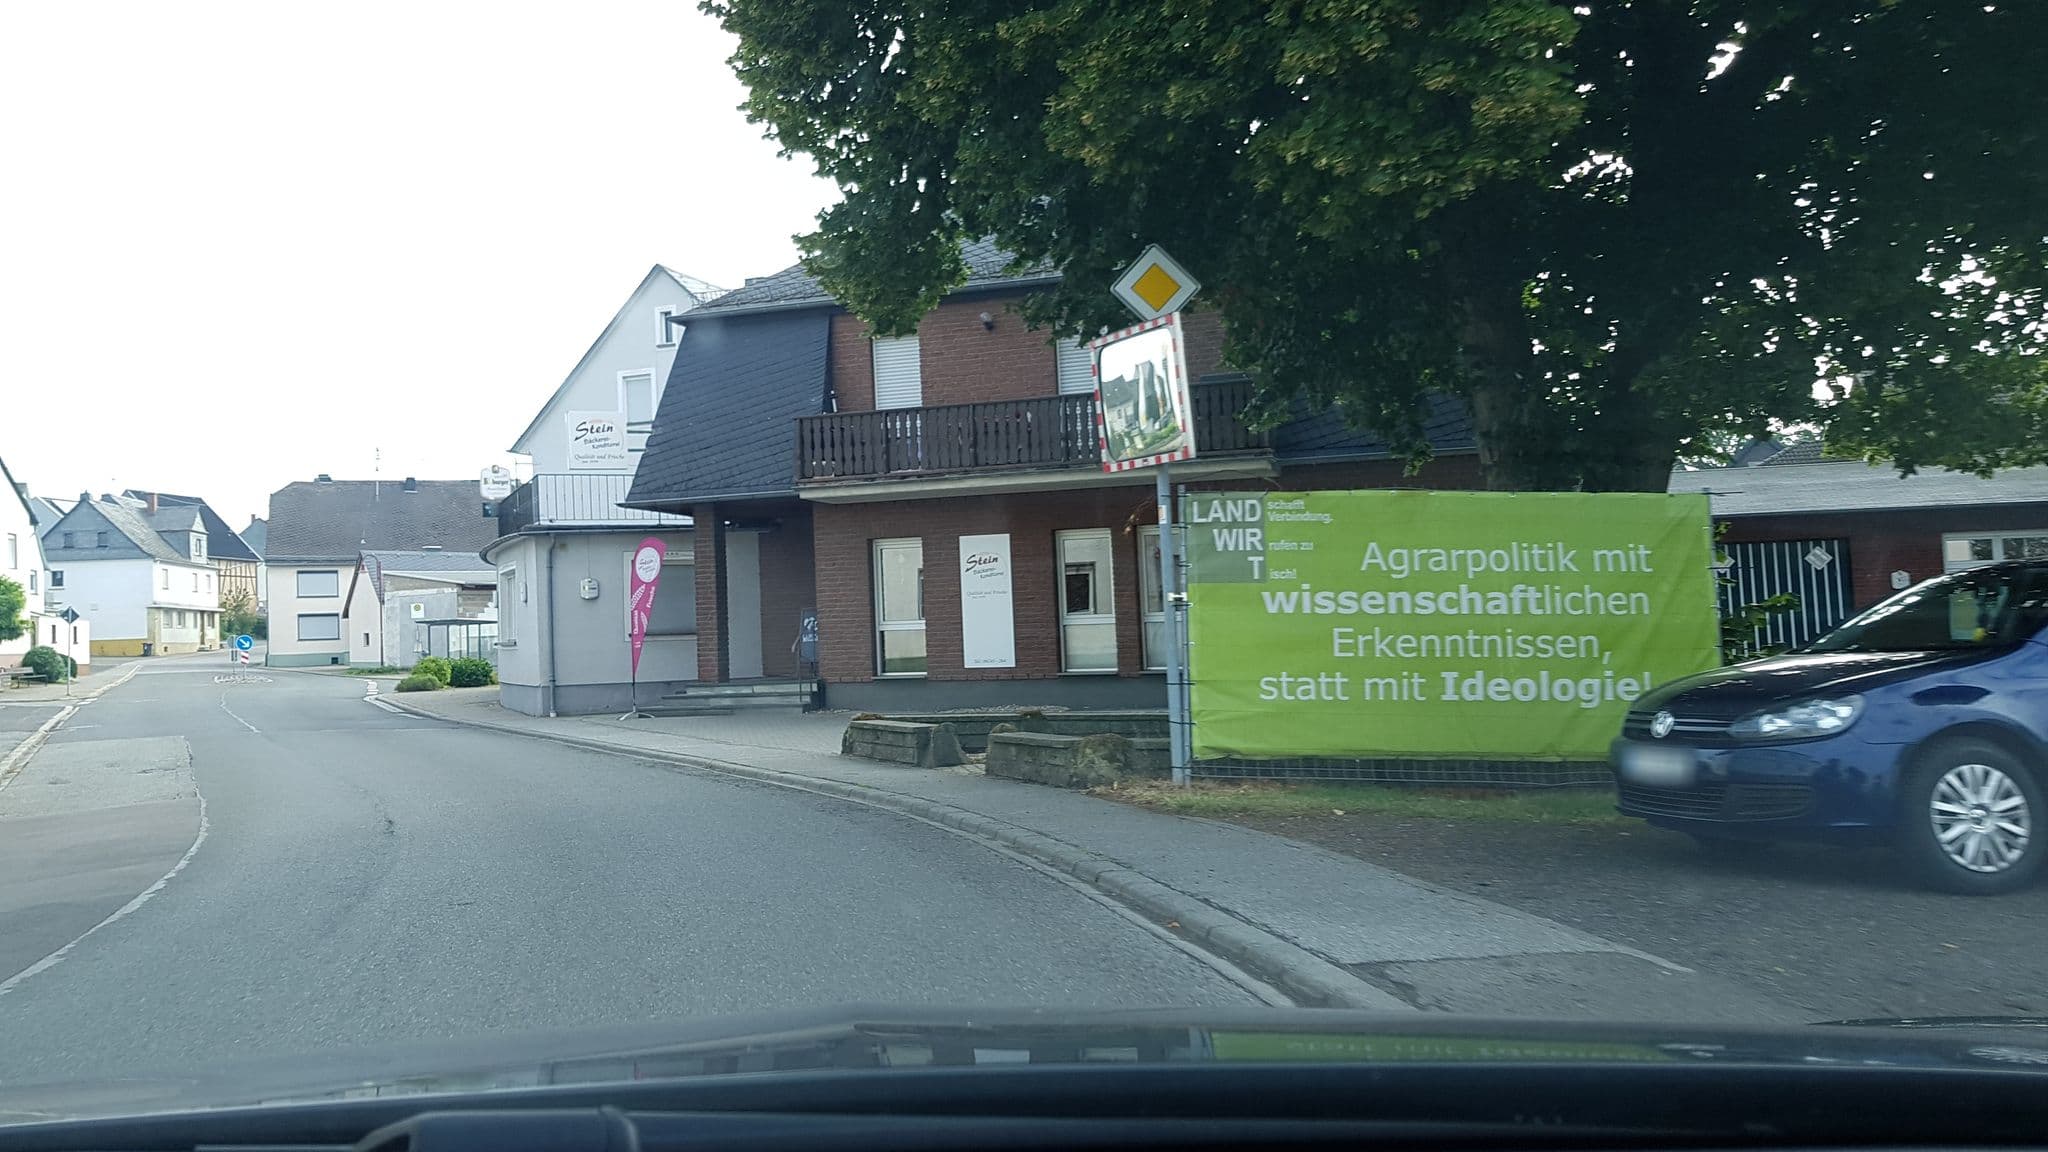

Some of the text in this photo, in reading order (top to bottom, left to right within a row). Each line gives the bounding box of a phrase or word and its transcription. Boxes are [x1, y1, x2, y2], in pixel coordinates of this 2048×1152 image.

[574, 421, 613, 441] Stein
[1192, 499, 1262, 523] LAND
[1212, 528, 1313, 551] WIR rufen zu
[965, 554, 998, 572] Stein
[1247, 556, 1264, 579] T
[1361, 541, 1652, 579] Agrarpolitik mit
[1261, 584, 1650, 615] wissenschaftlichen
[1332, 627, 1612, 664] Erkenntnissen,
[1260, 671, 1651, 708] statt mit Ideologie!
